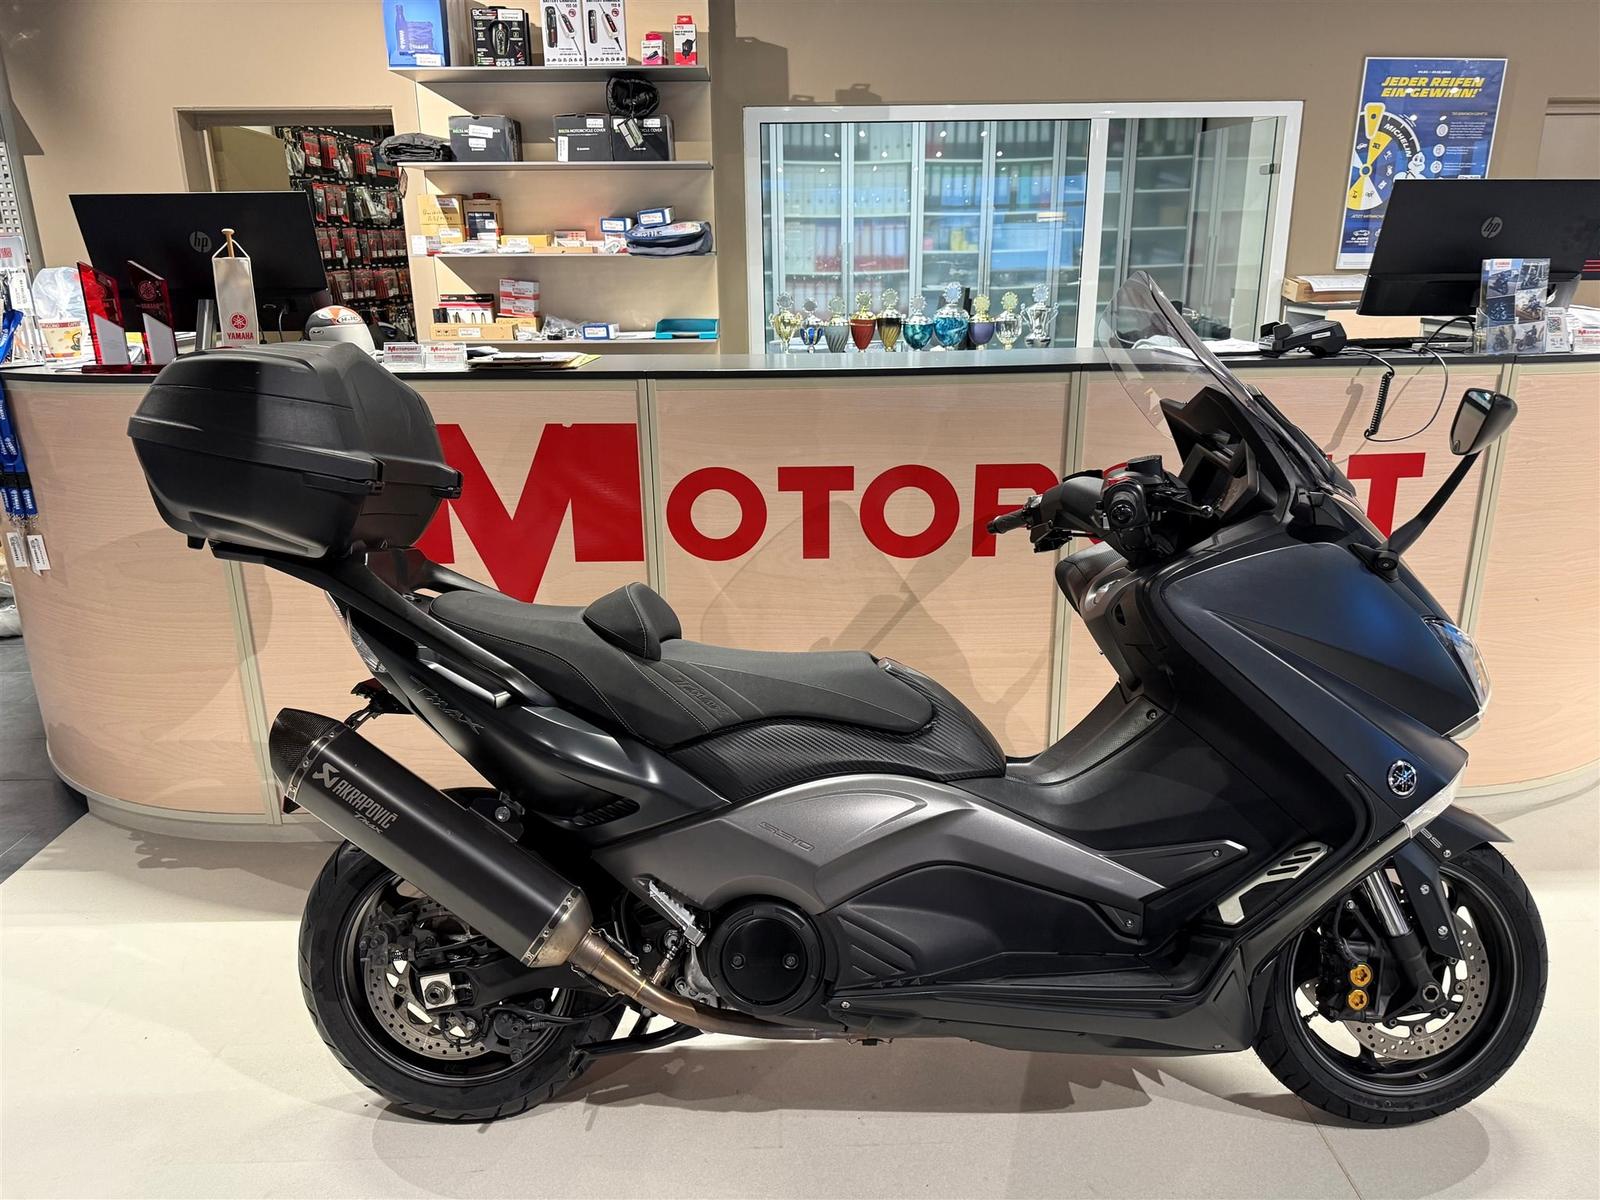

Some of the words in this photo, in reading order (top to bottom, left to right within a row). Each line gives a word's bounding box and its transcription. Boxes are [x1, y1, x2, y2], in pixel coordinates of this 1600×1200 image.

[1381, 77, 1429, 87] JEDER
[1429, 77, 1486, 88] REIFEN
[1381, 87, 1408, 98] EIN
[1384, 123, 1412, 158] MICHELIN
[1481, 217, 1504, 239] hp
[190, 231, 212, 253] hp
[227, 332, 254, 340] YAMAHA
[413, 422, 1426, 604] MOTOPT
[758, 821, 816, 852] 530
